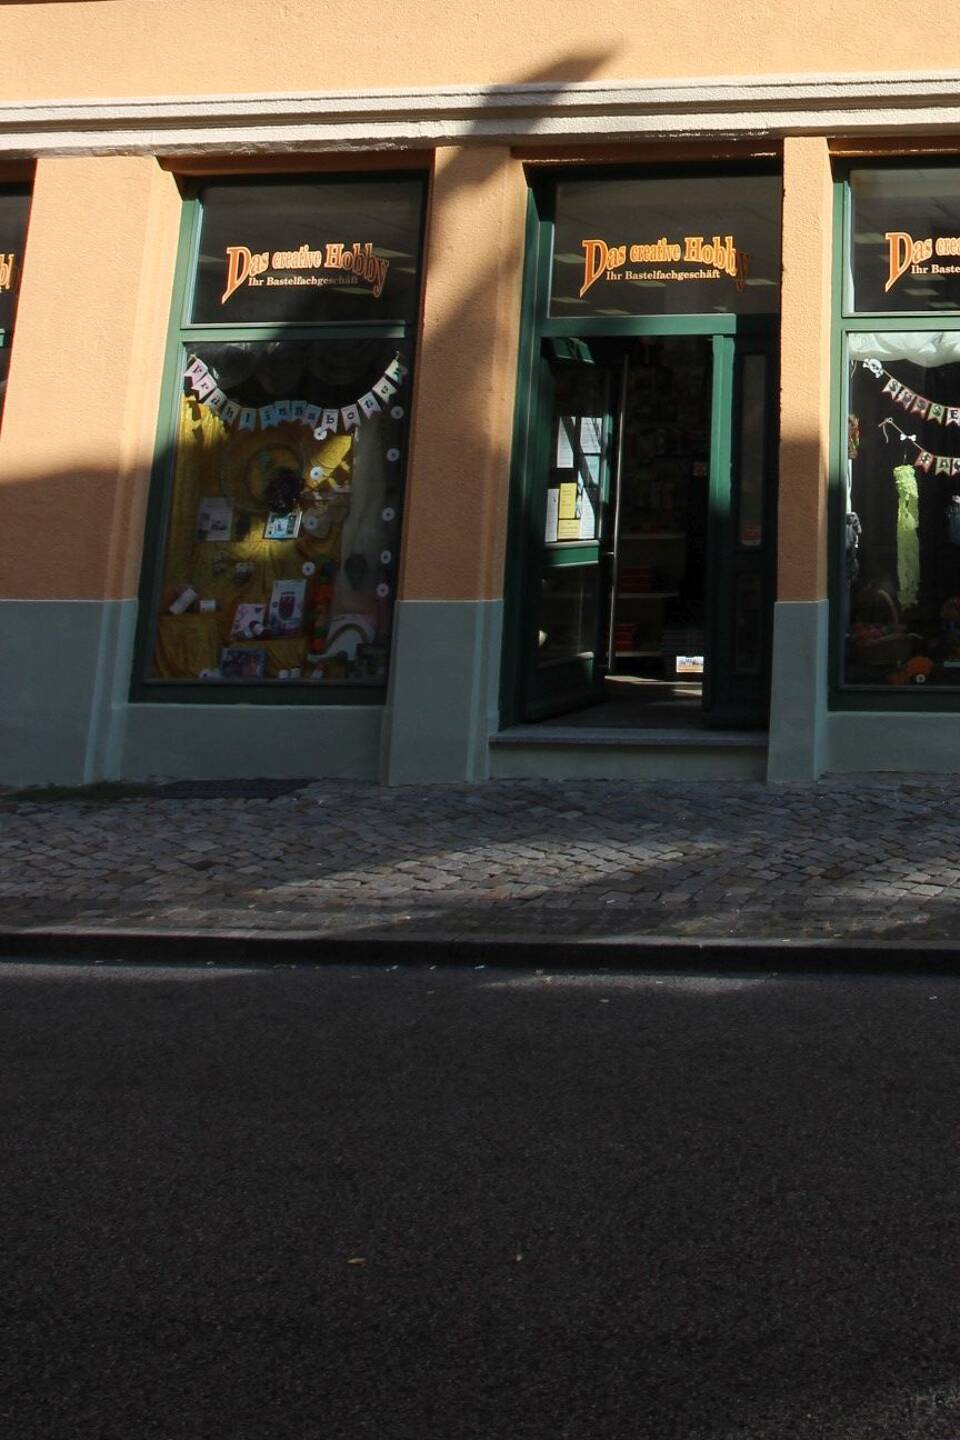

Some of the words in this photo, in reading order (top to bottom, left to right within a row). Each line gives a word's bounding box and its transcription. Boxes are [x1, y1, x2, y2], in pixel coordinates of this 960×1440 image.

[221, 246, 269, 304] Das
[272, 244, 322, 270] creative
[324, 242, 389, 298] Hobby
[579, 239, 626, 298] Das
[630, 237, 681, 262] creative
[606, 270, 622, 280] Ihr
[625, 269, 720, 281] Bastelfachgeschäft
[884, 231, 932, 292] Das
[911, 264, 928, 274] Ihr
[248, 277, 264, 286] Ihr
[267, 275, 358, 287] Bastelfachgeschäft
